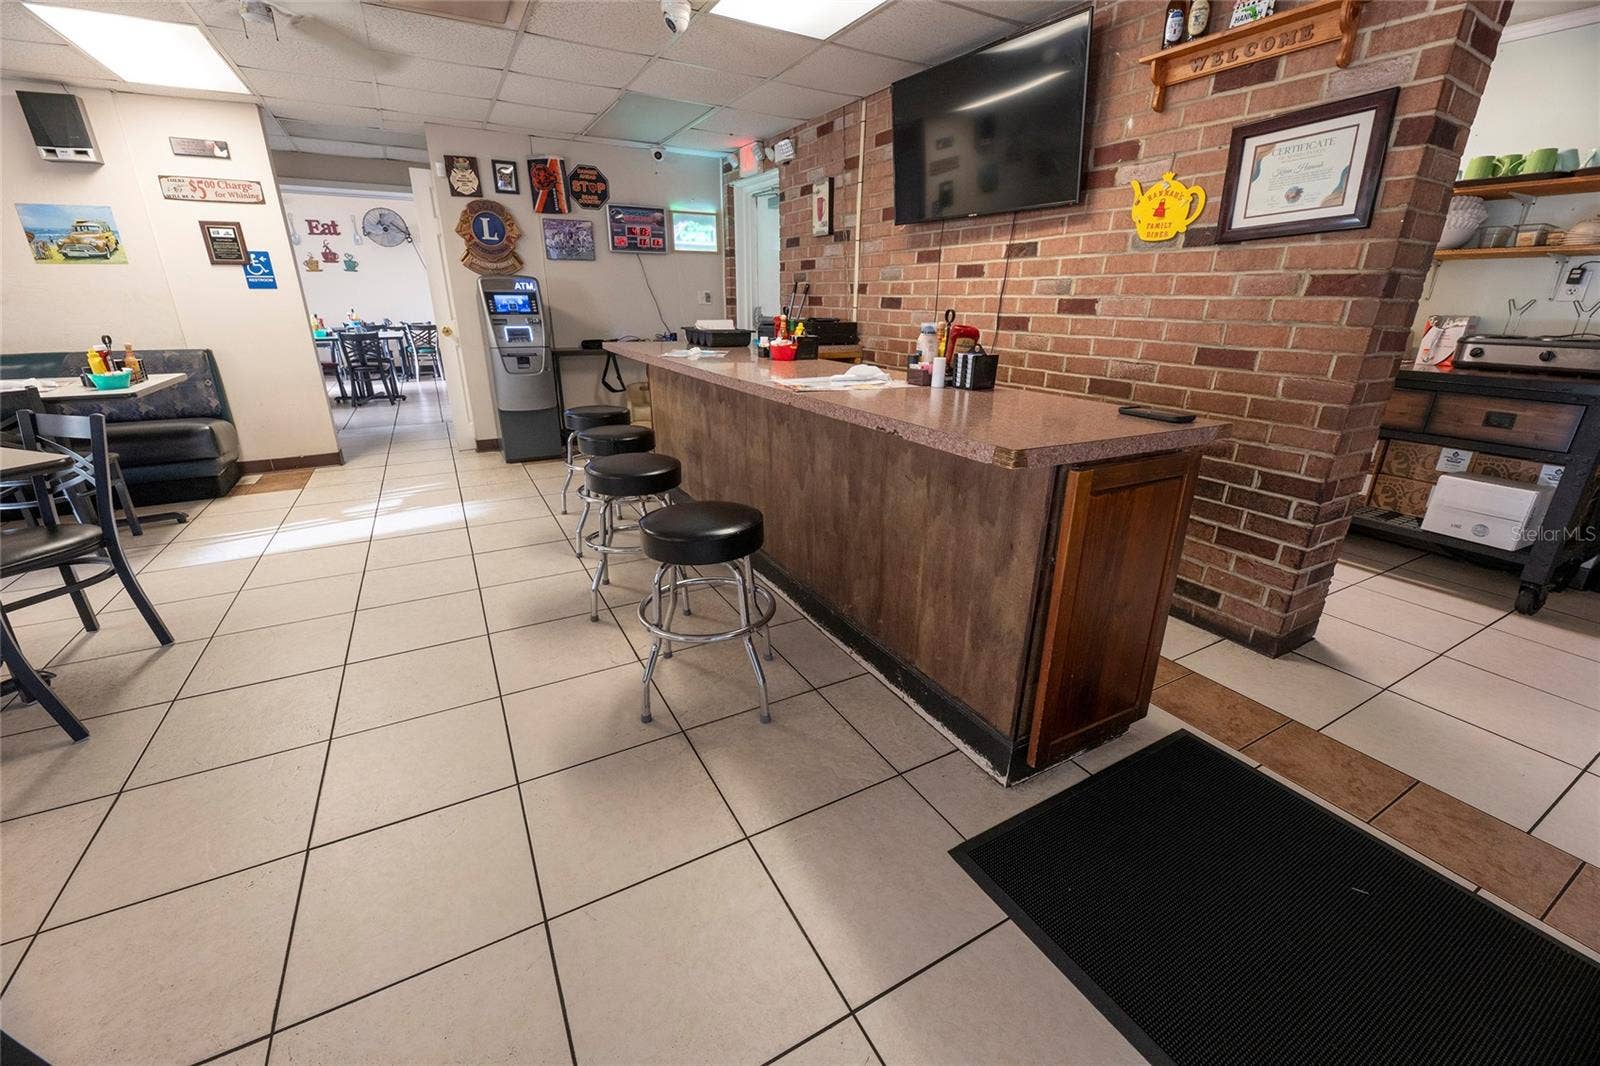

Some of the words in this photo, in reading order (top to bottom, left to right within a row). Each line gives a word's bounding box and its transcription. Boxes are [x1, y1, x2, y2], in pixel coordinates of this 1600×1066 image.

[1189, 24, 1315, 73] WELCOME
[1272, 137, 1337, 156] CERTIFICATE
[216, 180, 253, 193] Charge
[214, 190, 226, 199] for
[227, 190, 261, 202] Whining
[304, 218, 342, 236] Eat
[480, 216, 500, 241] L
[514, 281, 534, 291] ATM
